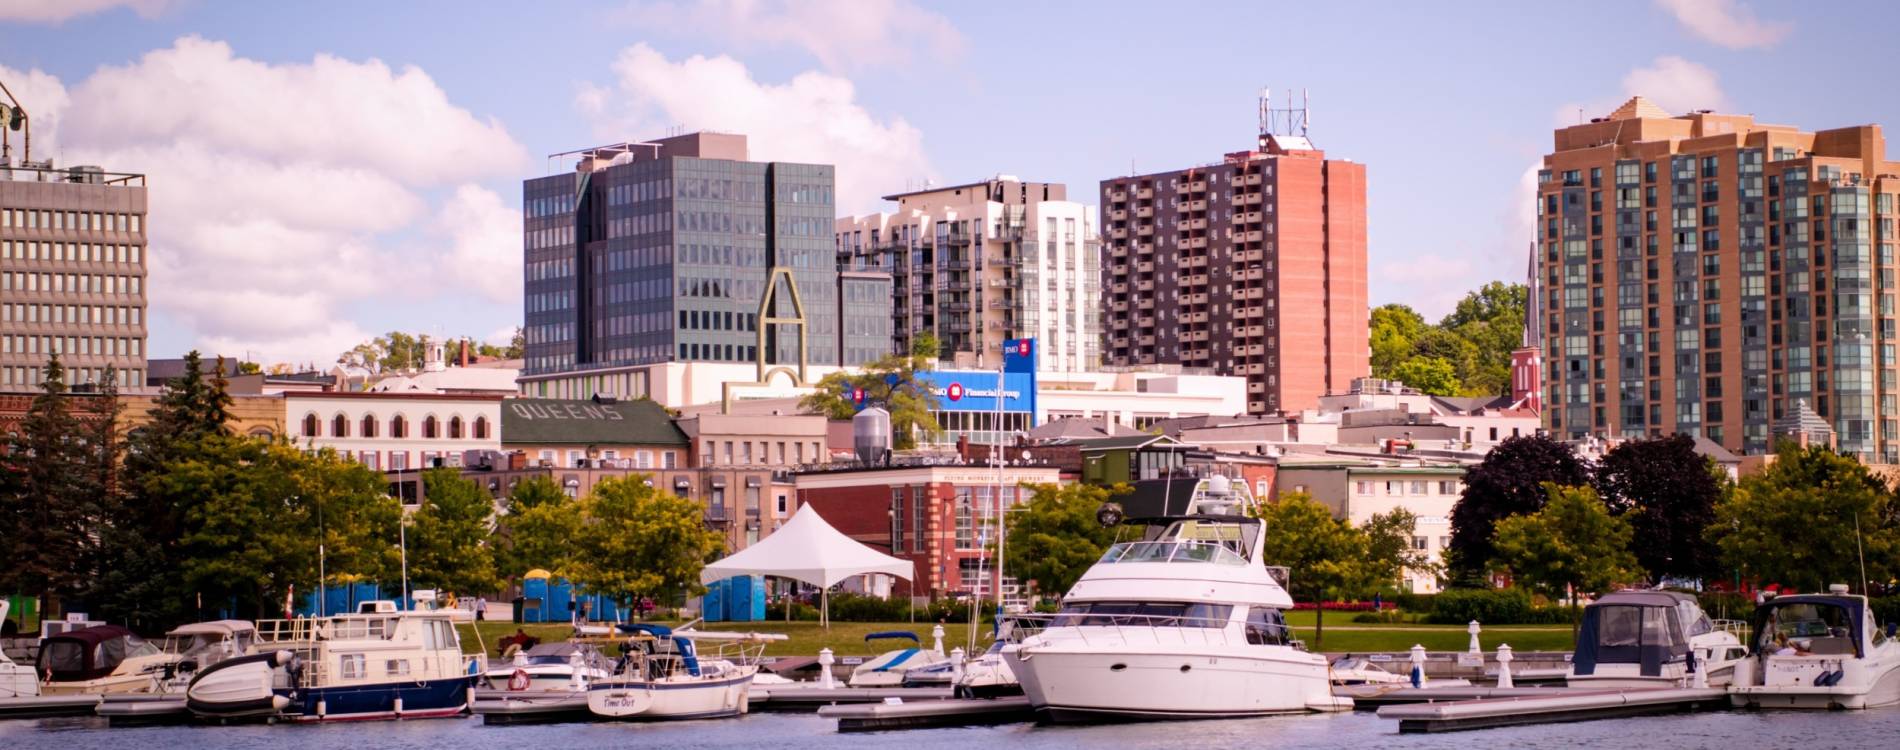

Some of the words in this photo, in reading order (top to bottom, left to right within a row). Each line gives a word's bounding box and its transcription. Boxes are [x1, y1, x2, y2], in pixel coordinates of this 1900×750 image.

[963, 386, 997, 398] Financial
[511, 403, 623, 420] QUEENS
[604, 698, 620, 707] Time
[621, 698, 635, 707] Out
